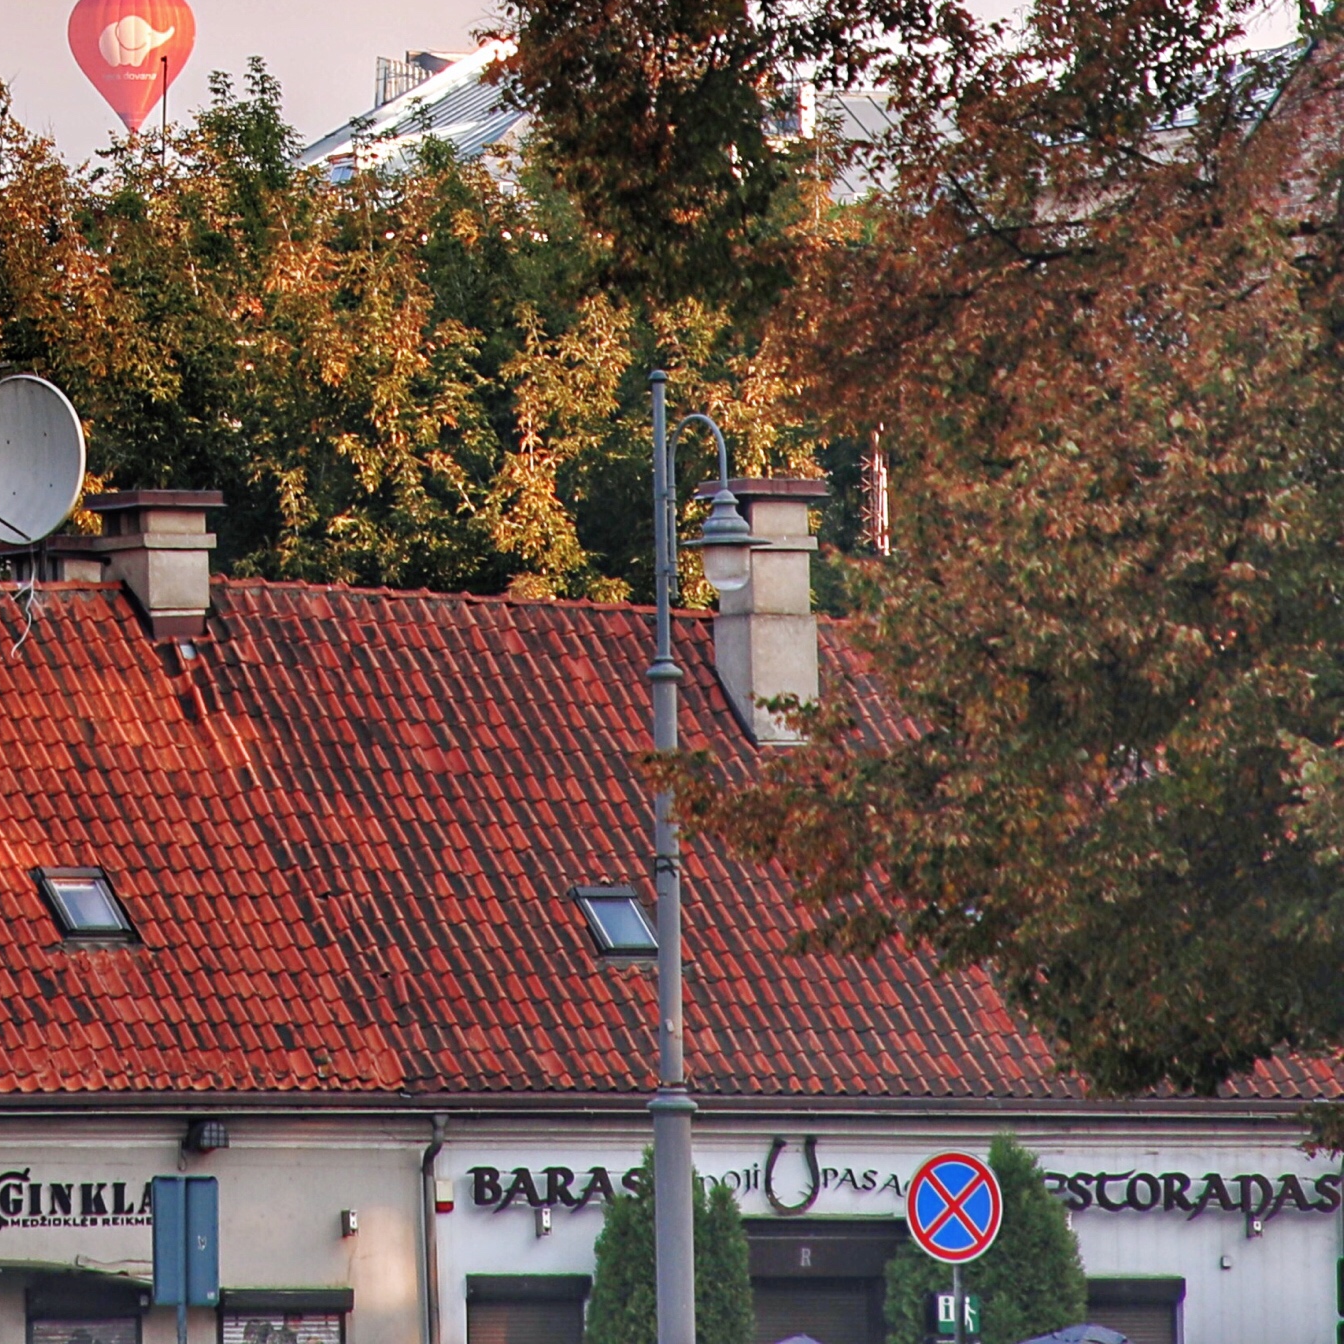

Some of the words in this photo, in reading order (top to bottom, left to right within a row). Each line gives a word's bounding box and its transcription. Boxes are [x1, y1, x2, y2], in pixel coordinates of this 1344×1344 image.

[466, 1166, 648, 1214] BARAS
[10, 1216, 98, 1228] MEDŽIOKLĖS
[101, 1216, 153, 1227] REIKME
[800, 1248, 812, 1267] R
